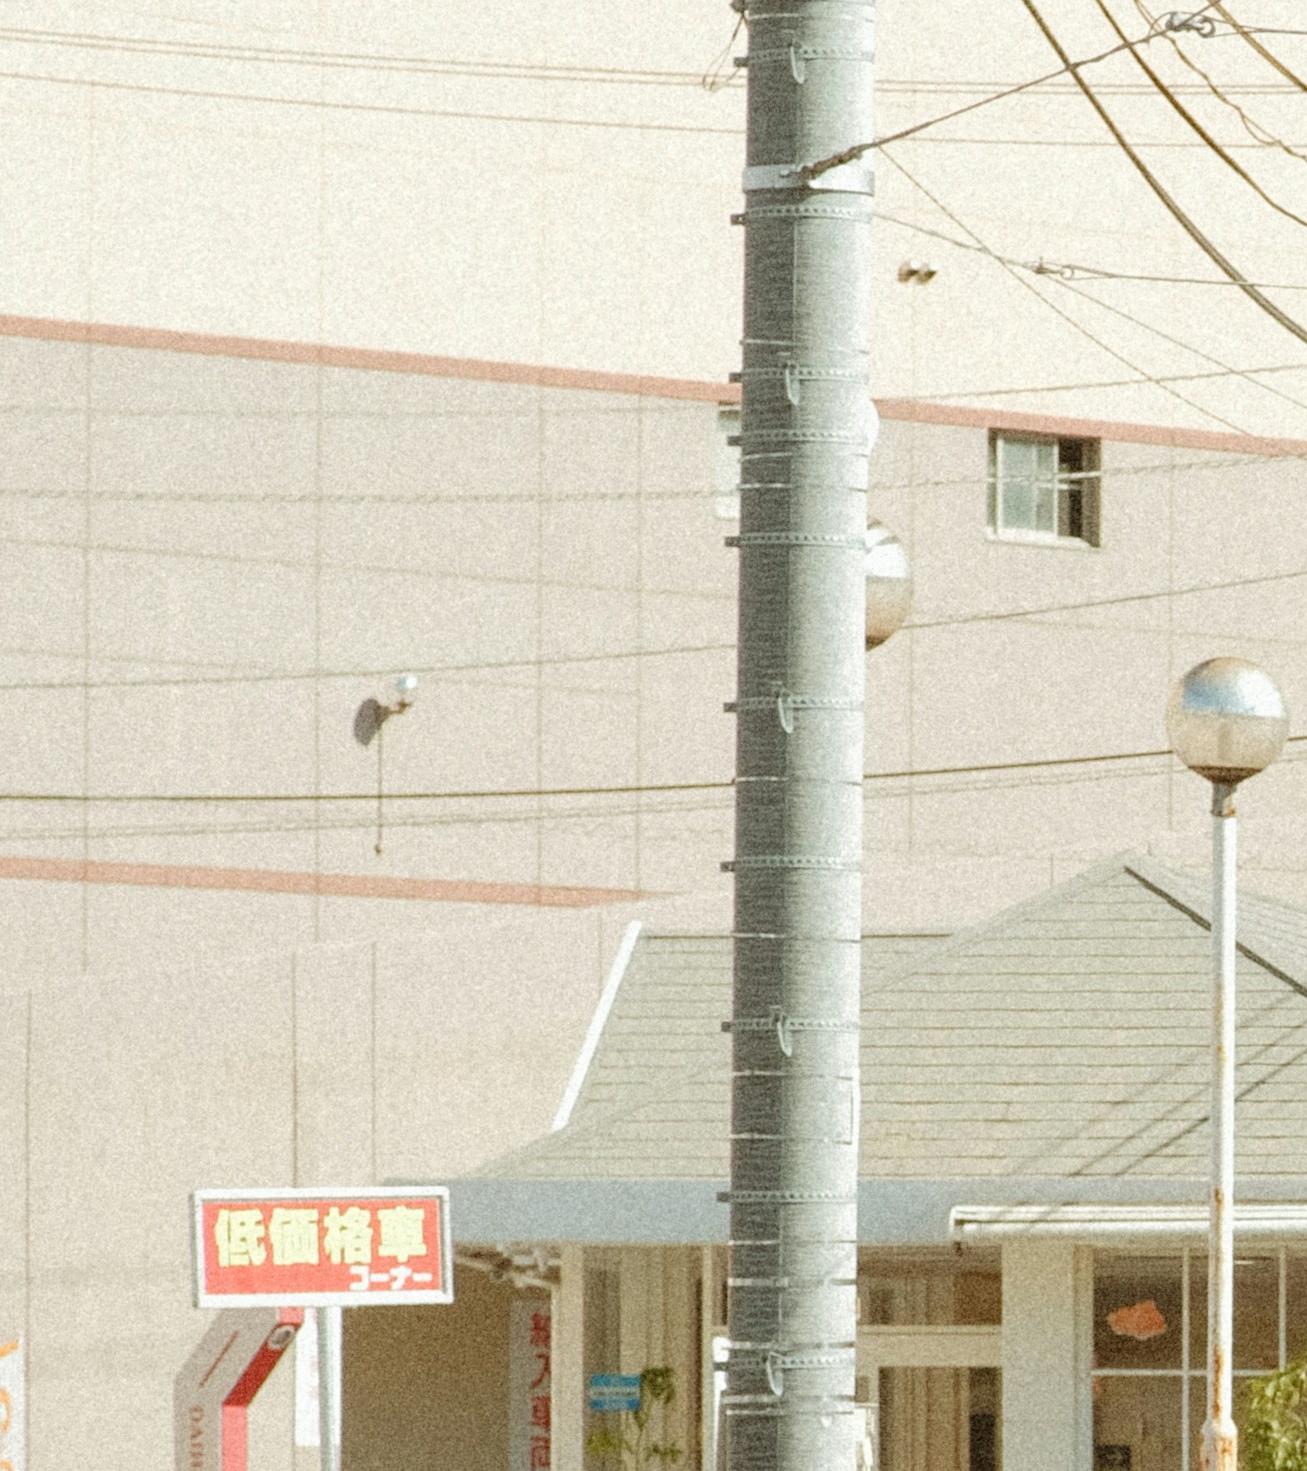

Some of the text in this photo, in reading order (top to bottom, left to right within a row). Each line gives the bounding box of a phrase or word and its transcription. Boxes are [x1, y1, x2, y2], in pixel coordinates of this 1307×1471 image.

[214, 1205, 427, 1267] 低価格車
[350, 1266, 432, 1291] コーナー
